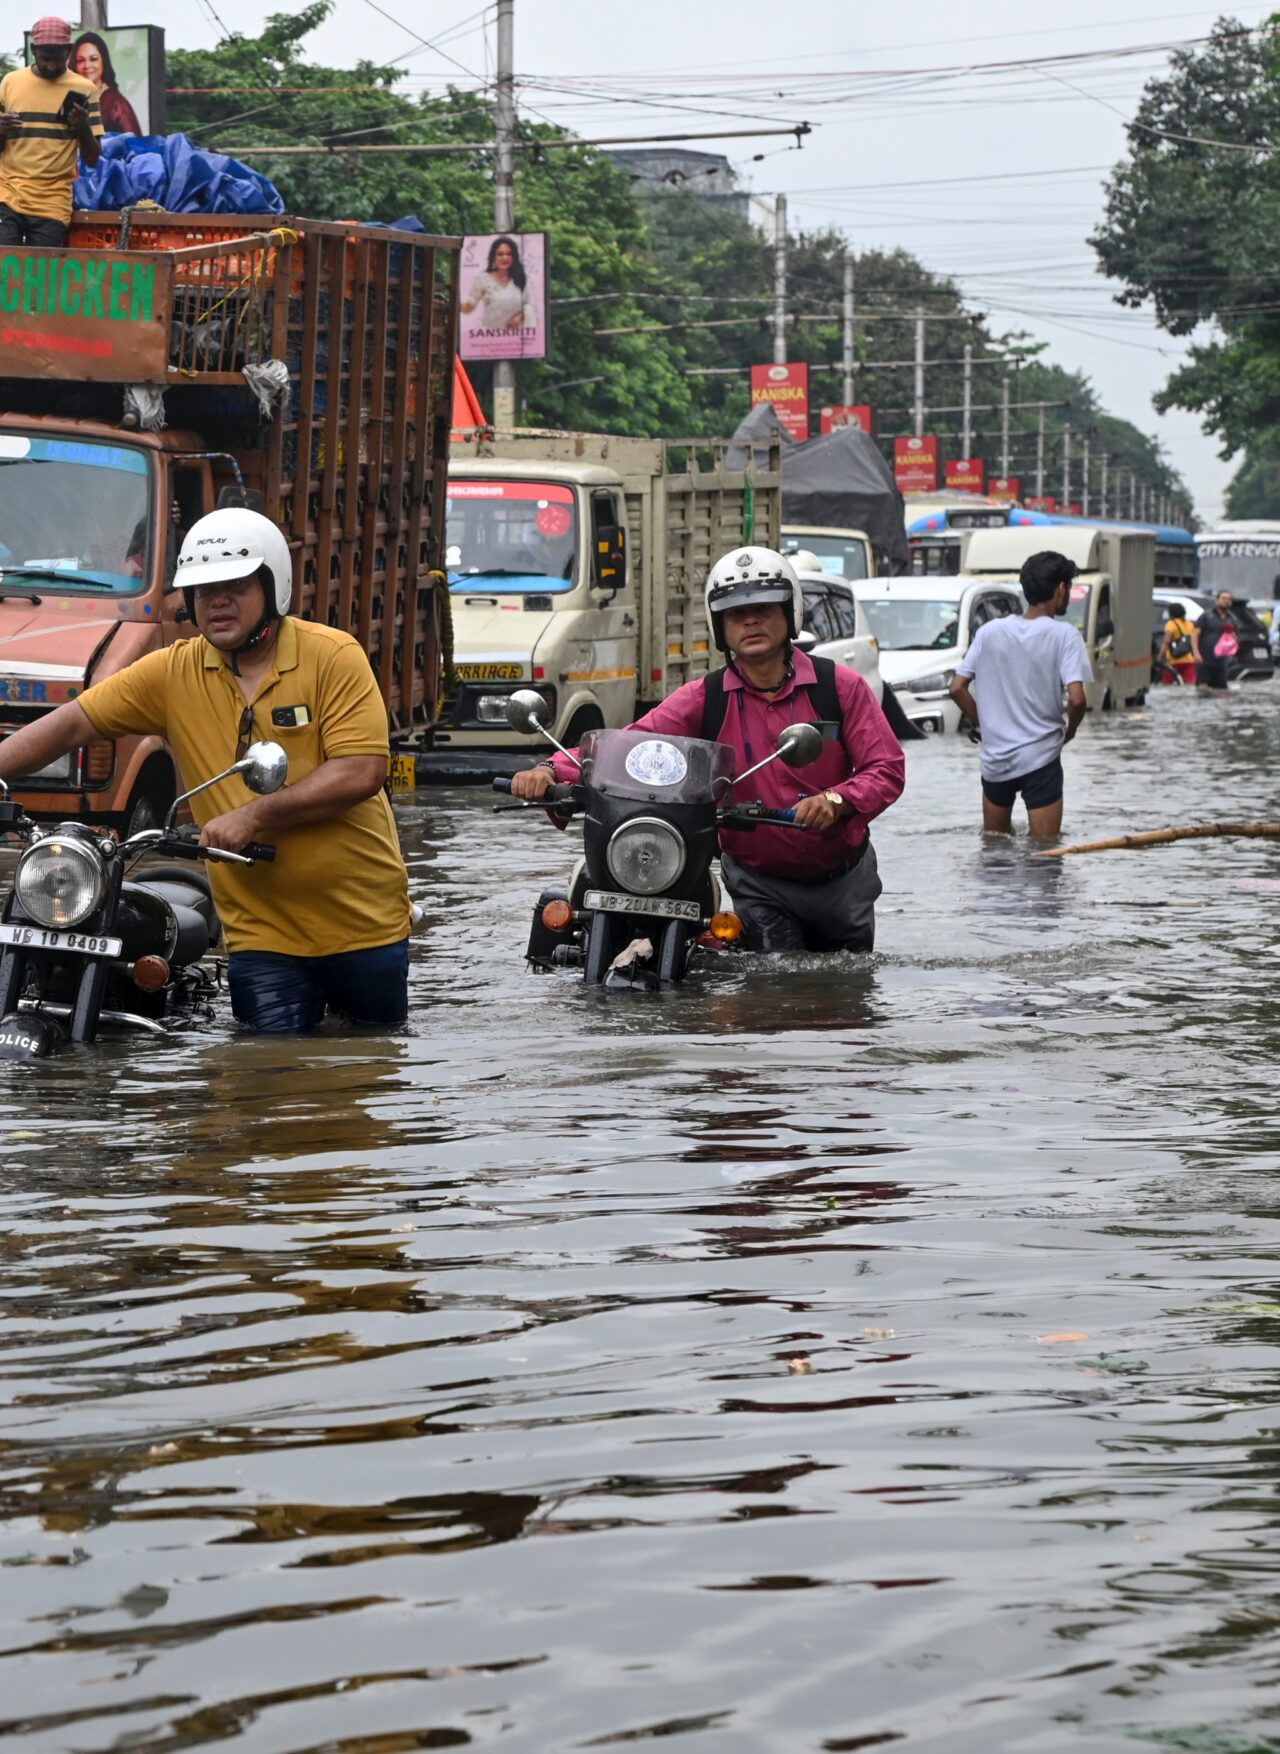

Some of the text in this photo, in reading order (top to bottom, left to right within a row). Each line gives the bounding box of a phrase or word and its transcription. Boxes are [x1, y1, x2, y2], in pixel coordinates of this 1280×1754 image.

[469, 327, 536, 339] SANSKRITI
[752, 387, 805, 401] KANISKA
[64, 444, 121, 465] GREAT
[896, 454, 934, 465] KANISKA
[196, 538, 227, 546] REPLAY
[1197, 543, 1226, 559] CITY
[666, 901, 699, 918] 5845
[13, 929, 108, 953] WB 10 0409
